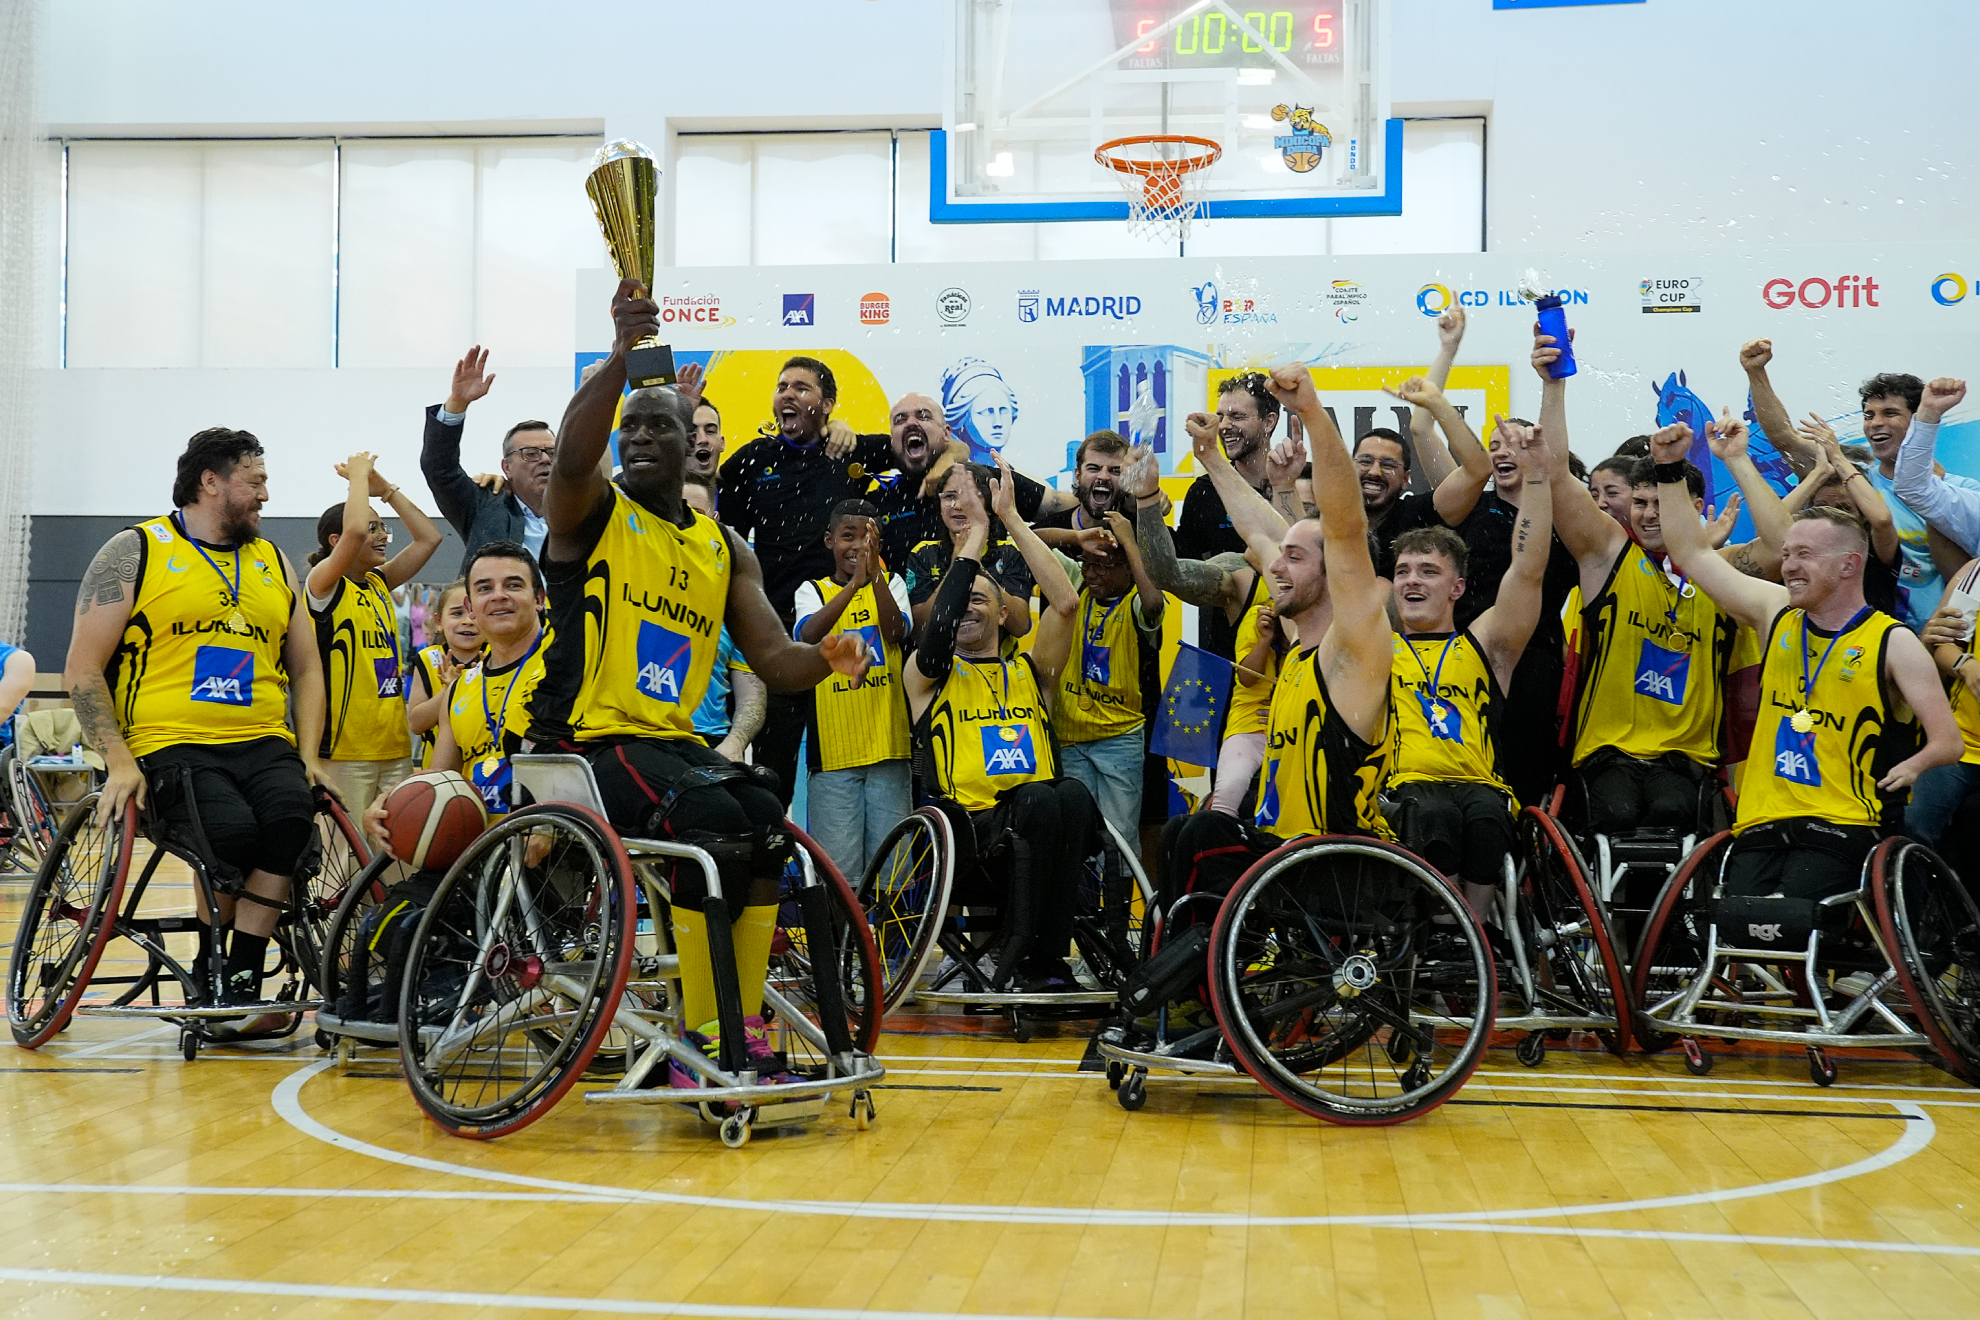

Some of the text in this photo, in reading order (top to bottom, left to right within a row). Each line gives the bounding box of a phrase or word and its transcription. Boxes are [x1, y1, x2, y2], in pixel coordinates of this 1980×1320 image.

[1175, 11, 1293, 55] 00:00
[1313, 13, 1334, 48] 5
[1129, 58, 1162, 69] FALTAS
[1306, 53, 1340, 64] FALTAS
[1349, 139, 1357, 170] MONDO
[1656, 279, 1689, 289] EURO
[663, 295, 720, 306] Fundación
[860, 302, 890, 310] BURGER
[1459, 289, 1588, 306] CD ILON
[1659, 293, 1686, 303] CUP
[662, 307, 720, 323] ONCE
[783, 310, 810, 325] AXA
[860, 309, 890, 320] KING
[1046, 296, 1142, 320] MADRID
[669, 566, 689, 591] 13
[623, 582, 713, 638] ILUNION
[851, 609, 870, 624] 13
[190, 676, 243, 701] AXA
[636, 661, 679, 697] AXA
[1634, 669, 1675, 699] AXA
[986, 748, 1030, 771] AXA
[1774, 750, 1810, 780] AXA
[1748, 923, 1783, 942] RGK
